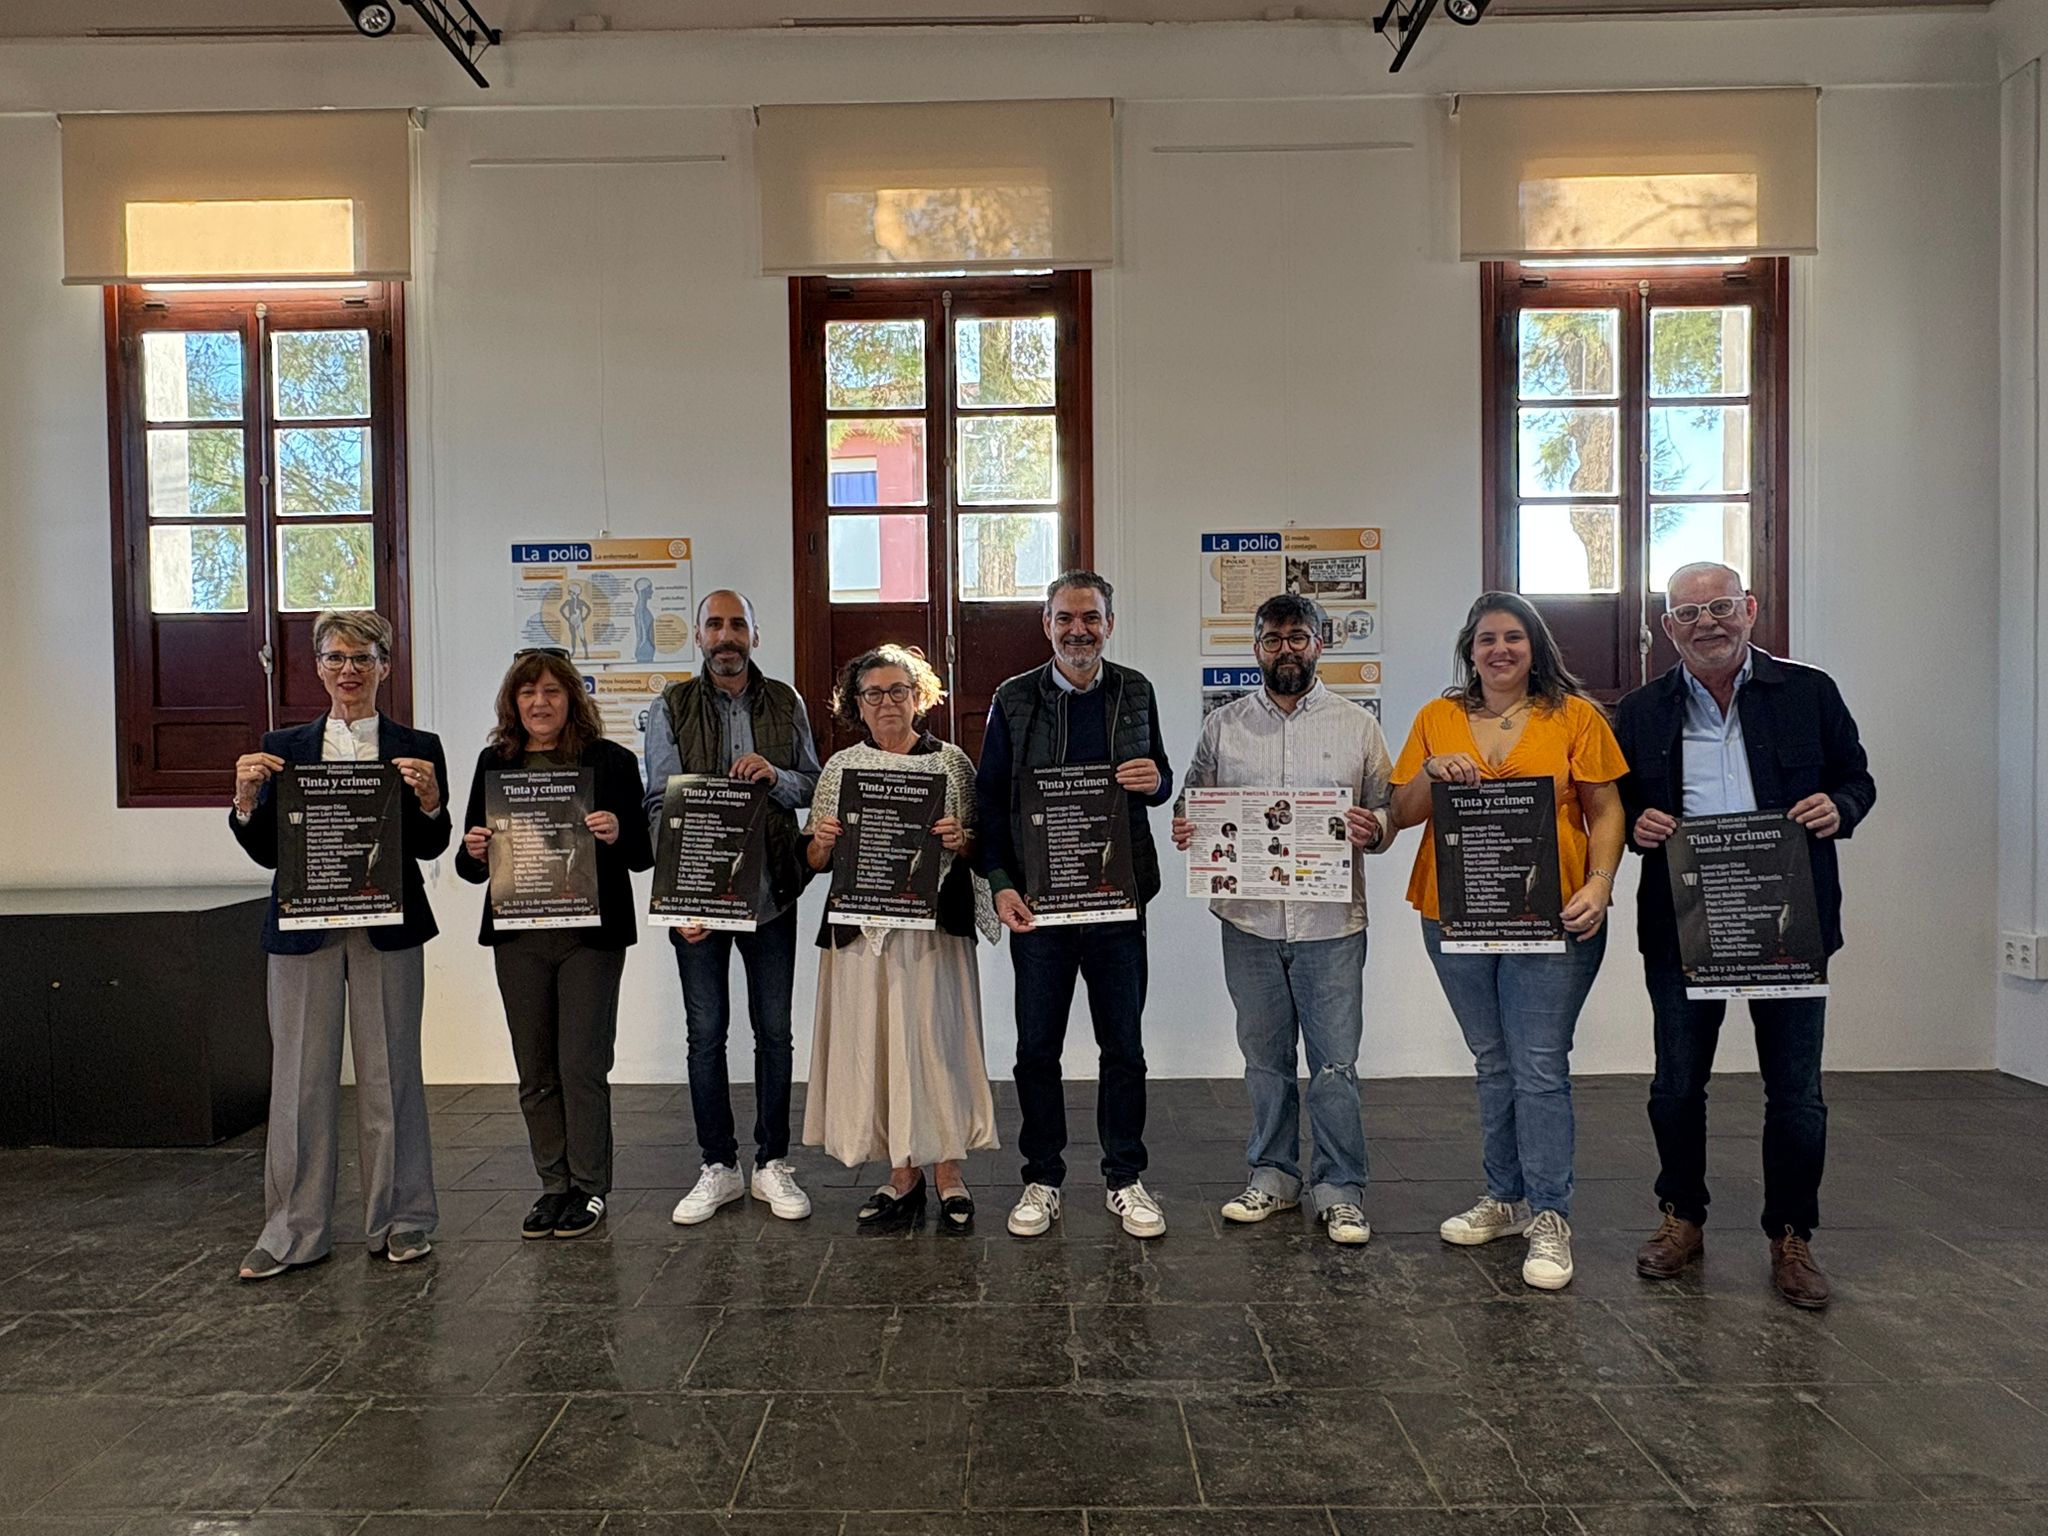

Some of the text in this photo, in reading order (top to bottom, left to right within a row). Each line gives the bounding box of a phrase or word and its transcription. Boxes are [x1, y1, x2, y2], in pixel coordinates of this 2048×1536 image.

[1213, 535, 1279, 551] La polio
[522, 547, 589, 562] La polio
[1214, 670, 1230, 684] La
[298, 776, 381, 788] Tinta y crimen
[502, 783, 575, 795] Tinta y crimen
[857, 781, 928, 795] Tinta y crimen
[1037, 776, 1109, 790] Tinta y crimen
[680, 787, 751, 799] Tinta y crimen
[1451, 794, 1534, 808] Tinta y crimen
[1686, 827, 1782, 845] Tinta y crimen
